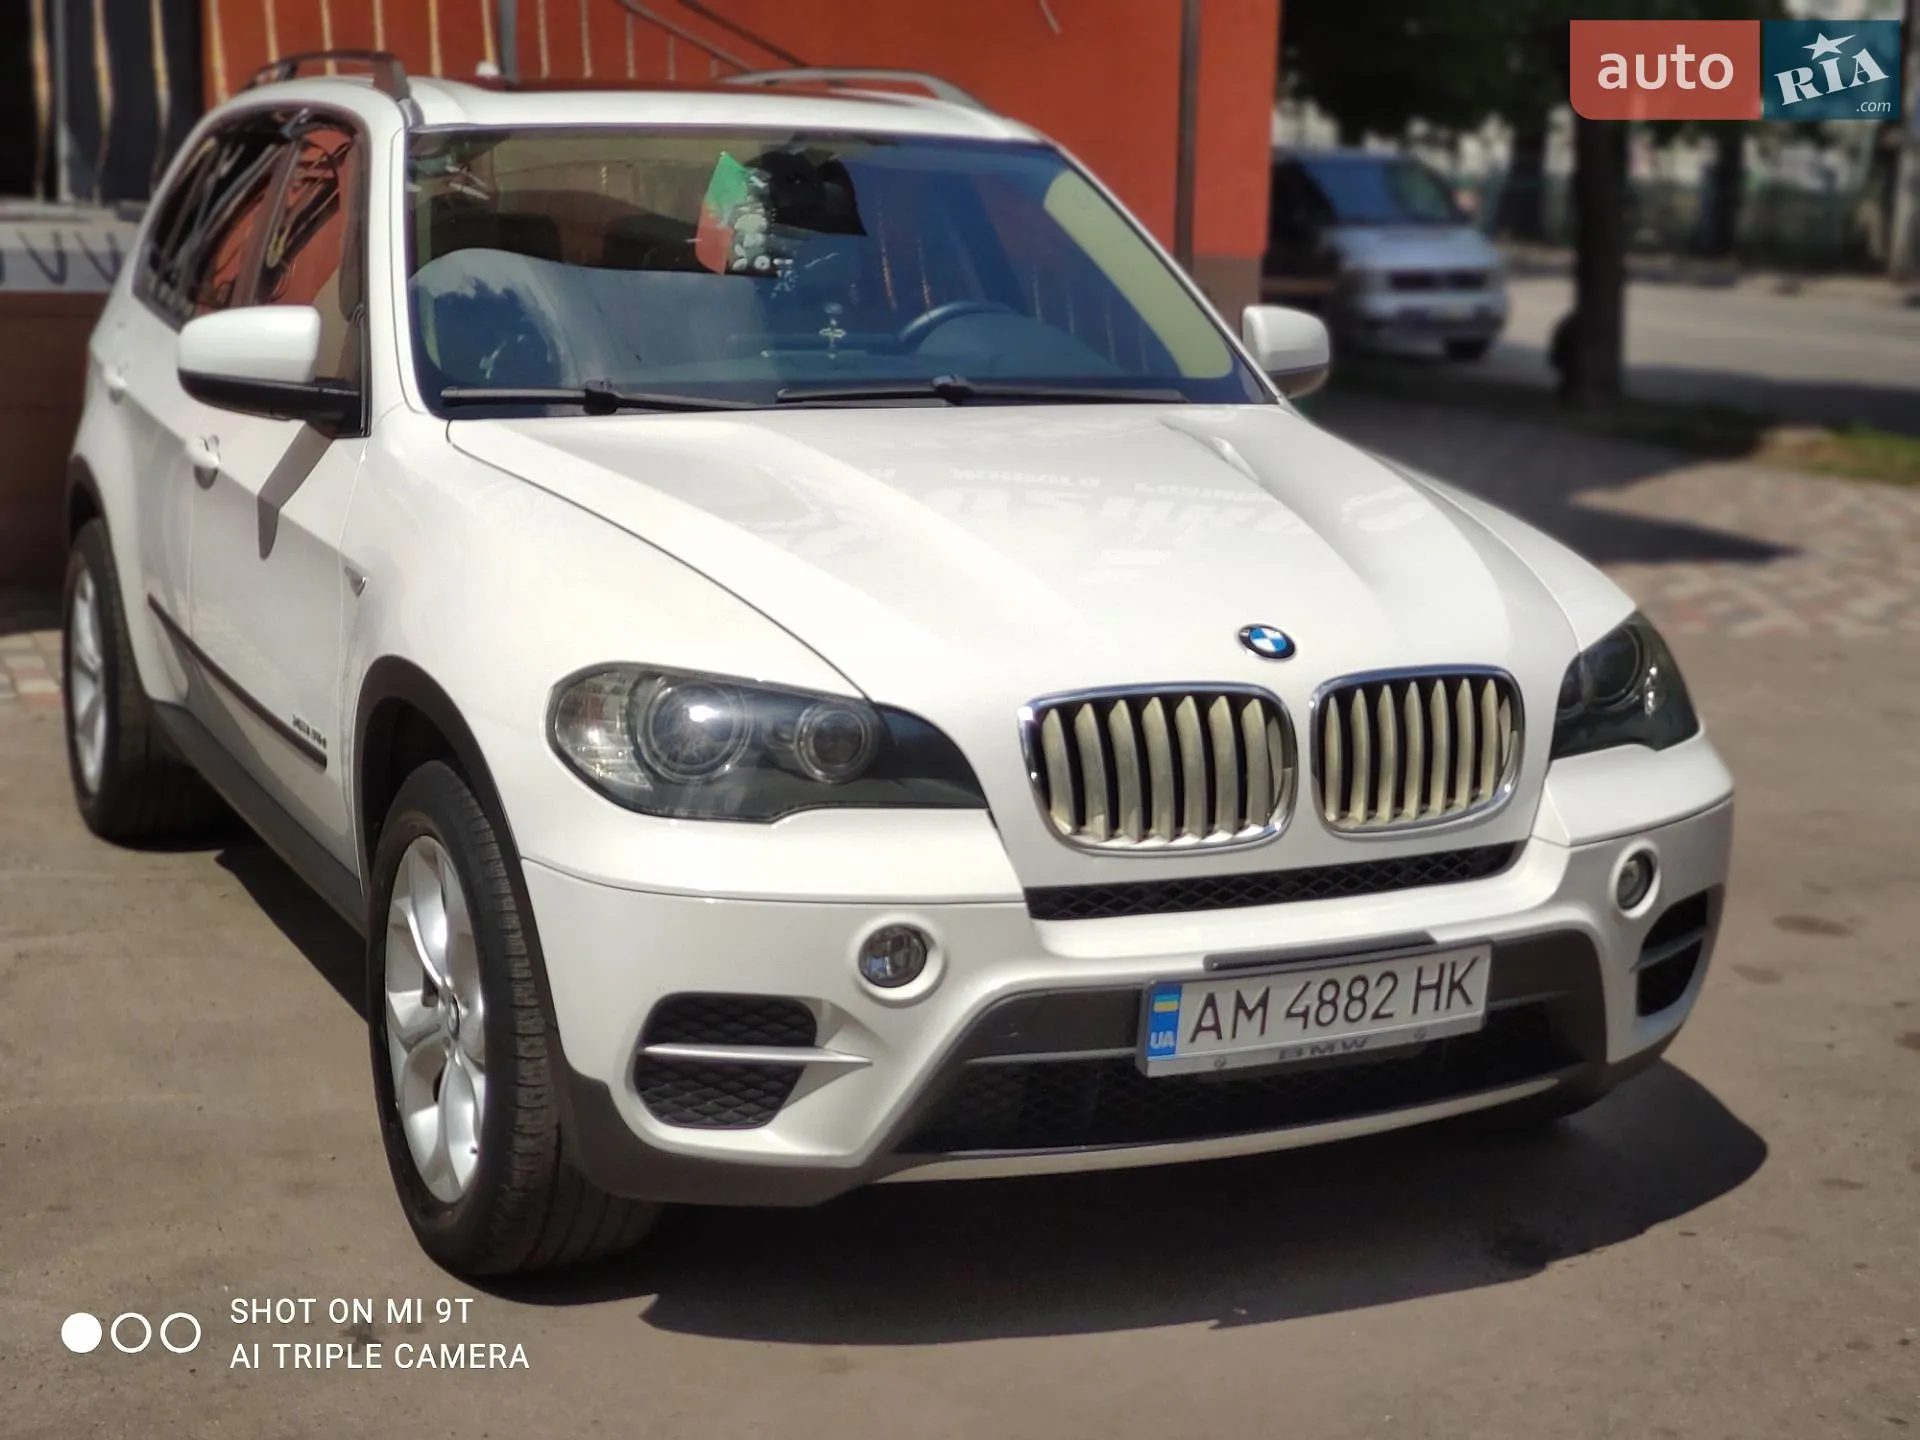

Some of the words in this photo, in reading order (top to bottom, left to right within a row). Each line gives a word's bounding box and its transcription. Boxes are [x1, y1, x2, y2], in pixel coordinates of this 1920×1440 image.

[1188, 986, 1271, 1044] AM
[1284, 971, 1399, 1031] 4882
[1411, 955, 1481, 1016] HK
[1150, 1030, 1175, 1049] UA
